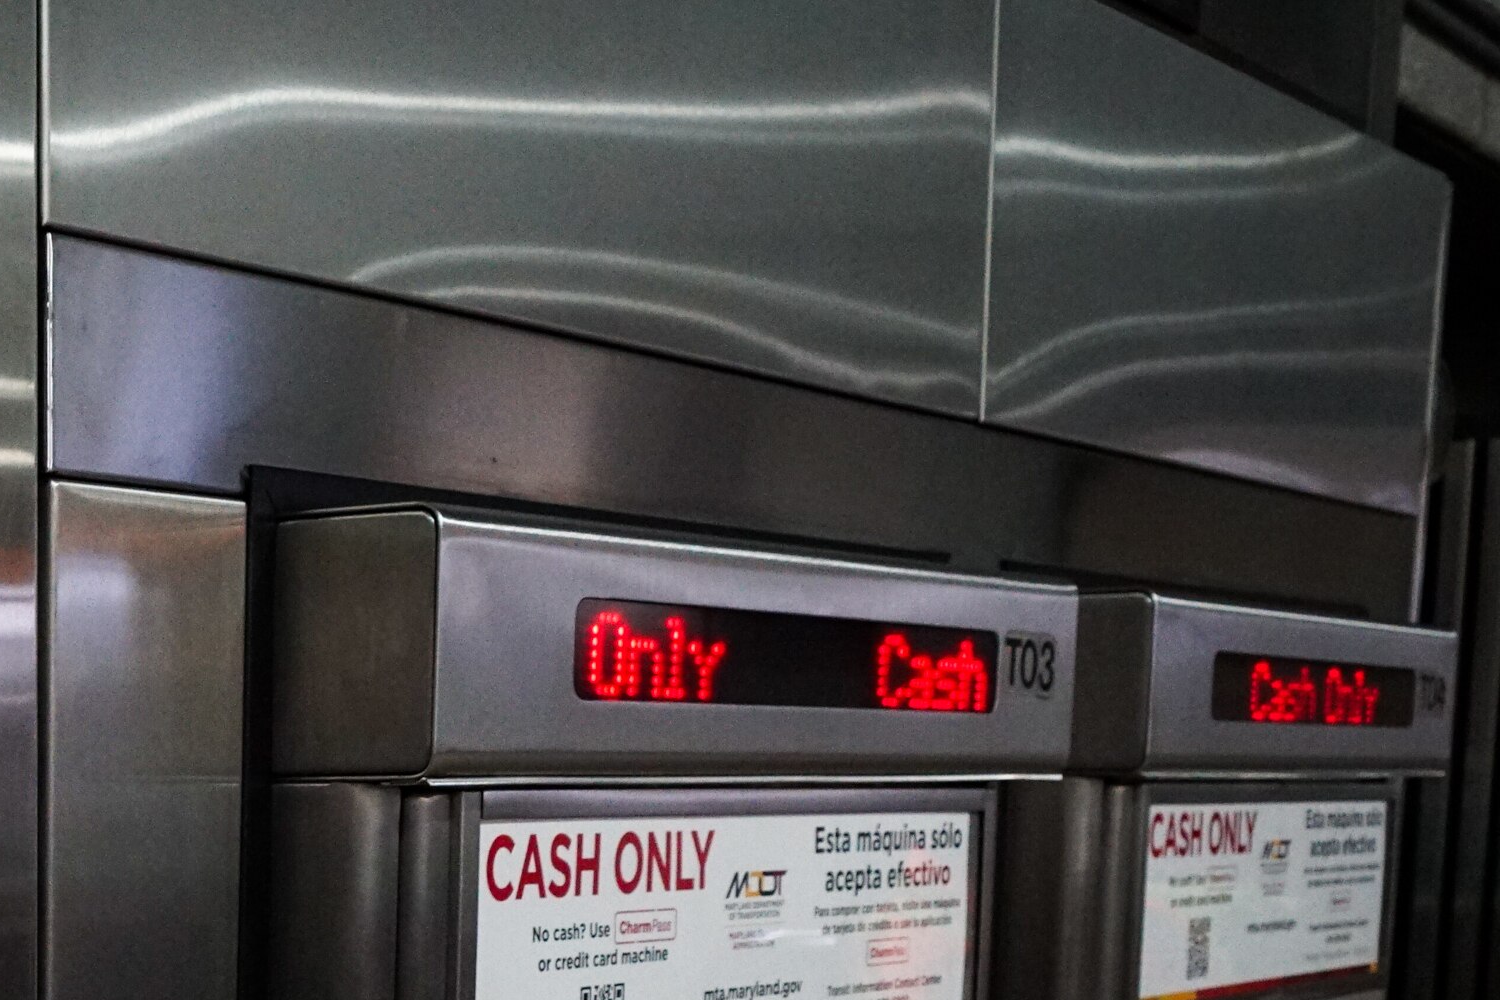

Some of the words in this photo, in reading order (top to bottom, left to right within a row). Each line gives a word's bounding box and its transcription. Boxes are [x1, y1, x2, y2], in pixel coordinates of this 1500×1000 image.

[590, 611, 726, 700] Only
[877, 634, 987, 712] Cash
[815, 827, 850, 854] Esta
[857, 824, 926, 856] máquina
[931, 823, 962, 849] sólo
[1150, 811, 1203, 858] CASH
[1208, 810, 1258, 855] ONLY
[486, 832, 602, 902] CASH
[614, 830, 715, 894] ONLY
[825, 868, 882, 895] acepta
[888, 860, 950, 887] efectivo
[532, 927, 550, 943] No
[553, 923, 586, 942] cash?
[590, 923, 610, 938] Use
[538, 958, 551, 972] or
[555, 953, 589, 970] credit
[593, 950, 617, 967] card
[621, 946, 668, 964] machine
